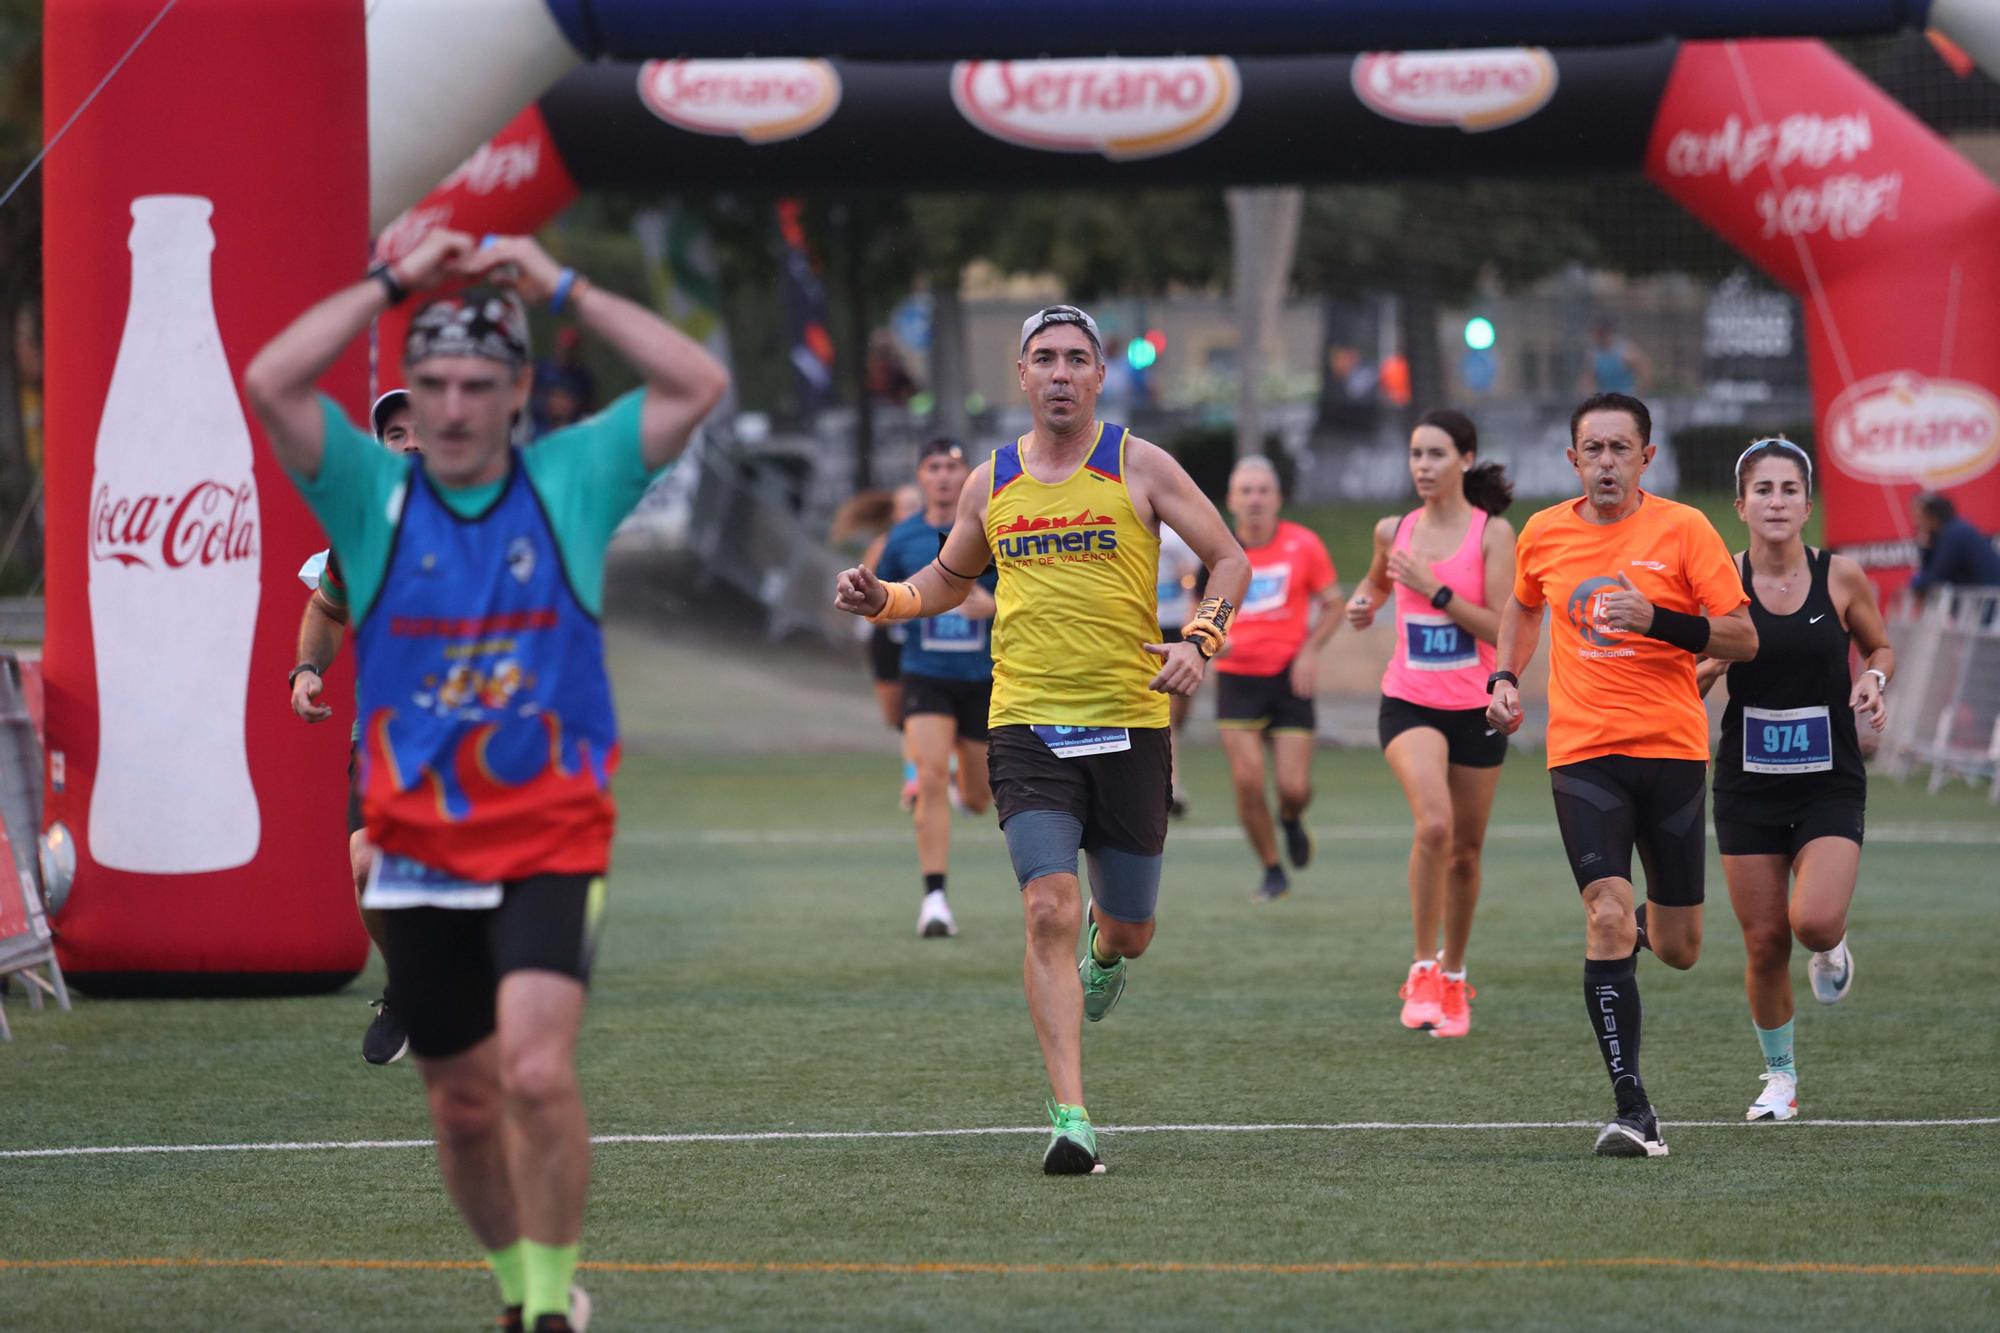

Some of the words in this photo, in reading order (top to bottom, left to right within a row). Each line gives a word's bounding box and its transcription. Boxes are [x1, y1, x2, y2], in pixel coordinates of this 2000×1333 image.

[997, 60, 1206, 113] Serrano
[1848, 404, 1989, 451] Serrano
[91, 478, 256, 570] Coca-Cola
[998, 530, 1117, 559] runners
[1039, 556, 1055, 566] DE
[1422, 628, 1457, 653] 747
[1763, 724, 1810, 752] 974
[1596, 985, 1624, 1073] kalenji
